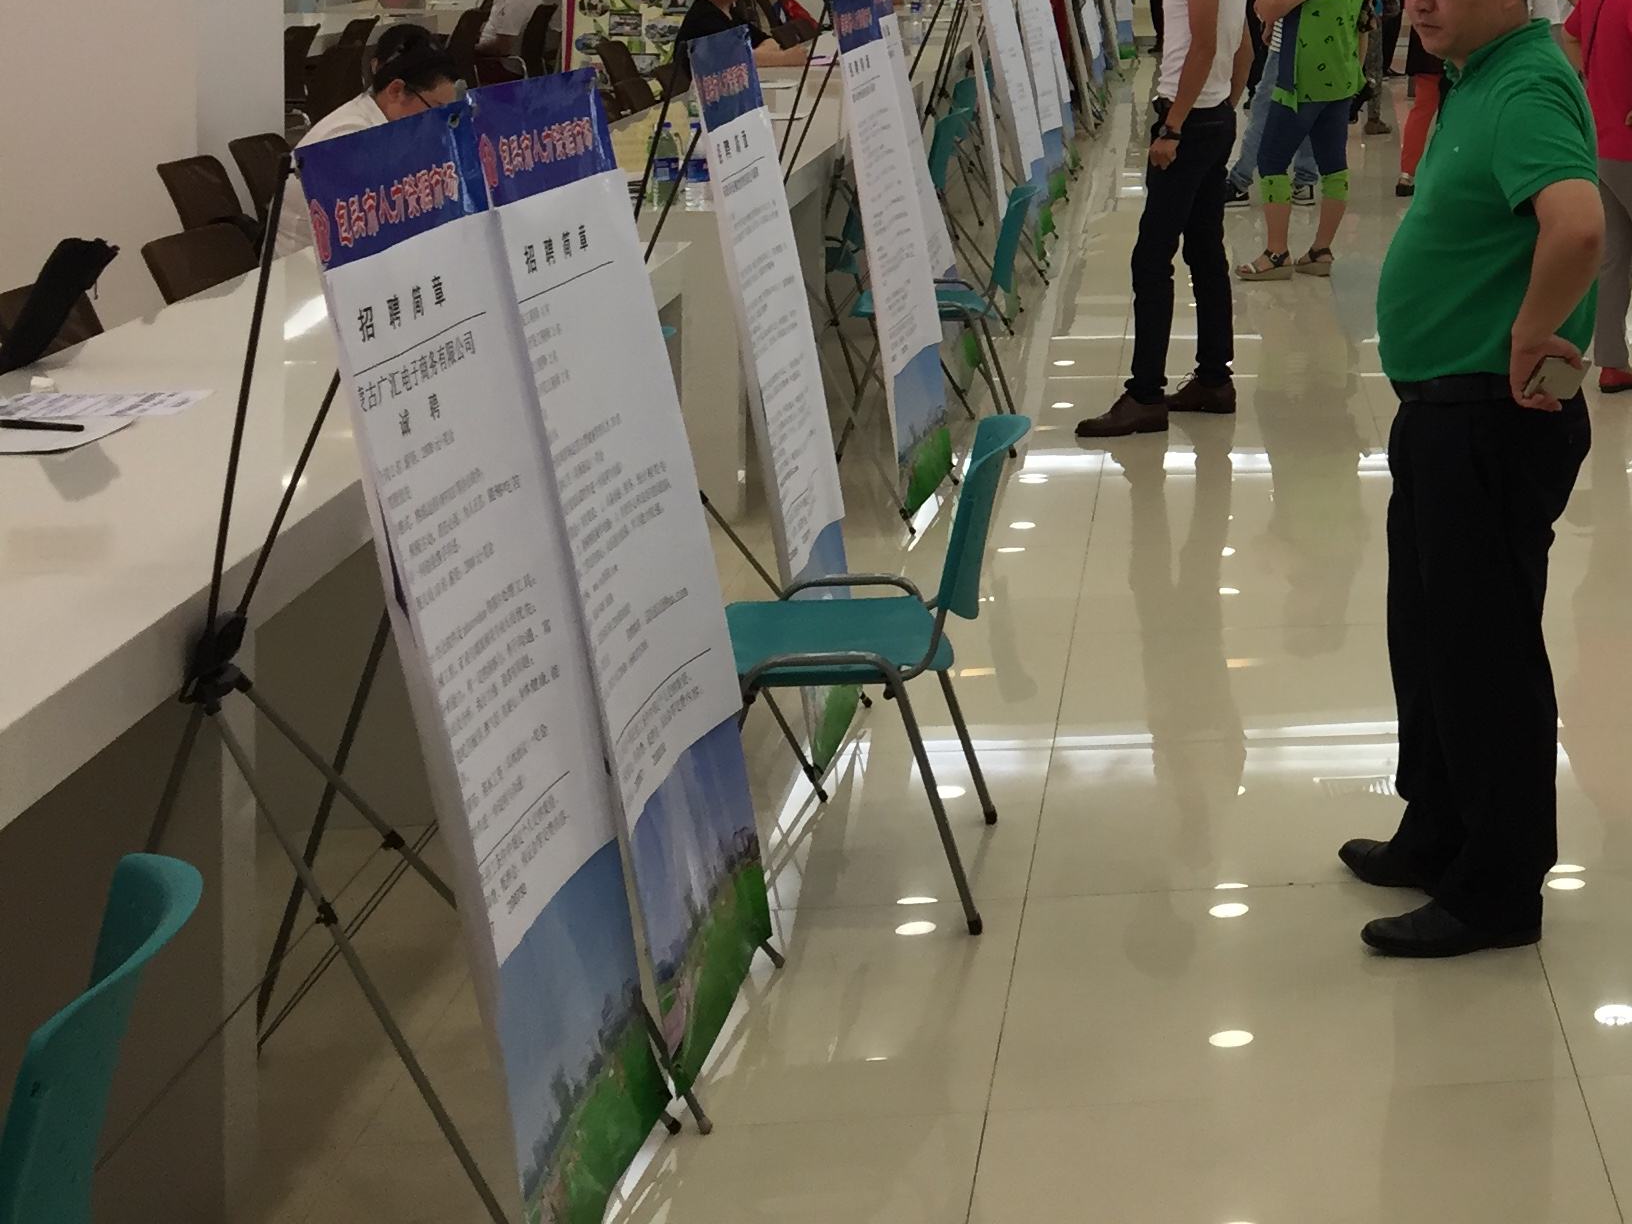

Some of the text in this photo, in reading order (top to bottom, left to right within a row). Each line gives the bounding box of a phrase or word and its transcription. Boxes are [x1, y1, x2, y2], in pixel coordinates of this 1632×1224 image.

[335, 161, 459, 248] 包头市人力资源市场
[357, 275, 447, 343] 招聘简章
